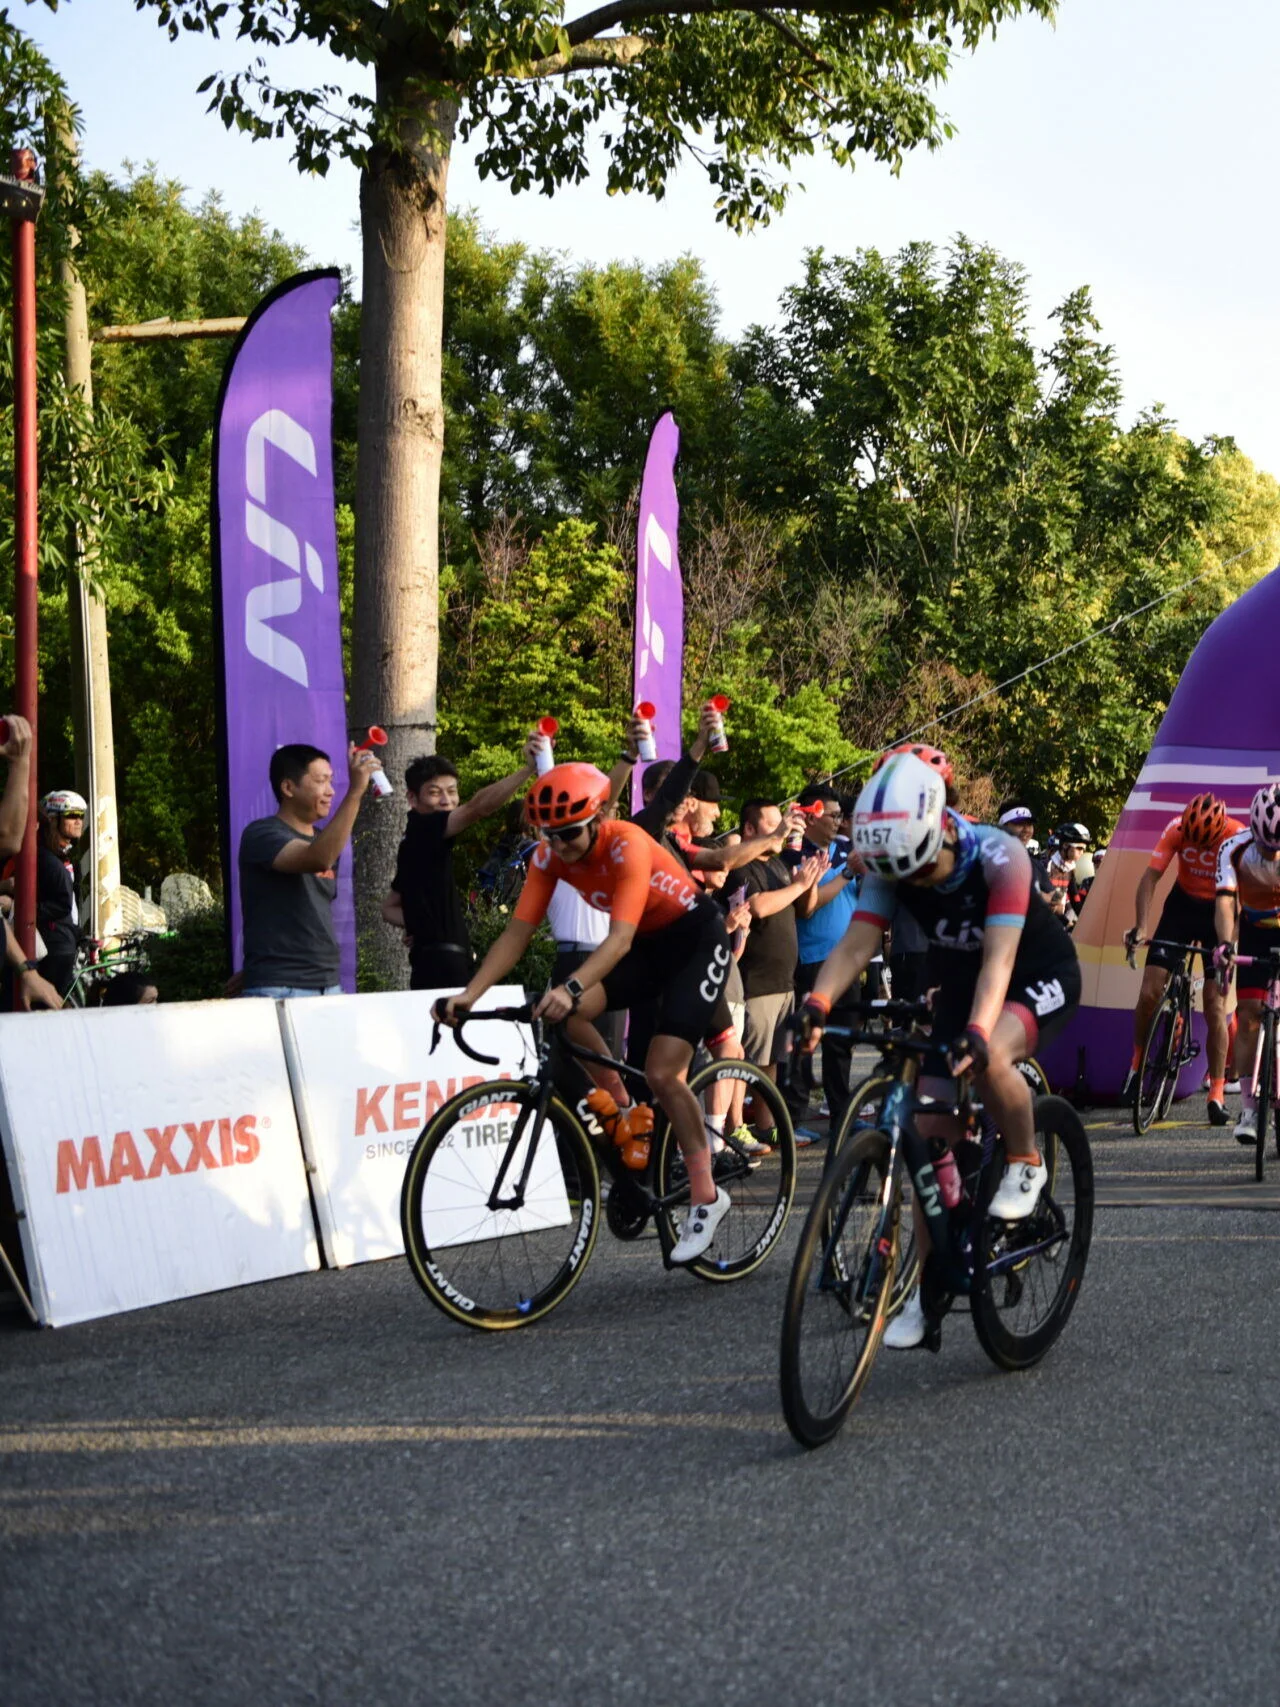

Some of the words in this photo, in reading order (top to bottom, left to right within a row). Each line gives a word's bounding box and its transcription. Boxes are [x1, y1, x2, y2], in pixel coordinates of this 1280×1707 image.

[246, 409, 324, 688] Liv
[856, 828, 892, 845] 4157
[1182, 847, 1216, 867] CC
[650, 871, 681, 896] CCC
[700, 944, 730, 1002] CCC
[717, 1067, 760, 1084] GIANT
[458, 1091, 518, 1118] GIANT
[56, 1114, 260, 1194] MAXXIS
[569, 1198, 593, 1271] GIANT
[425, 1261, 476, 1311] GIANT
